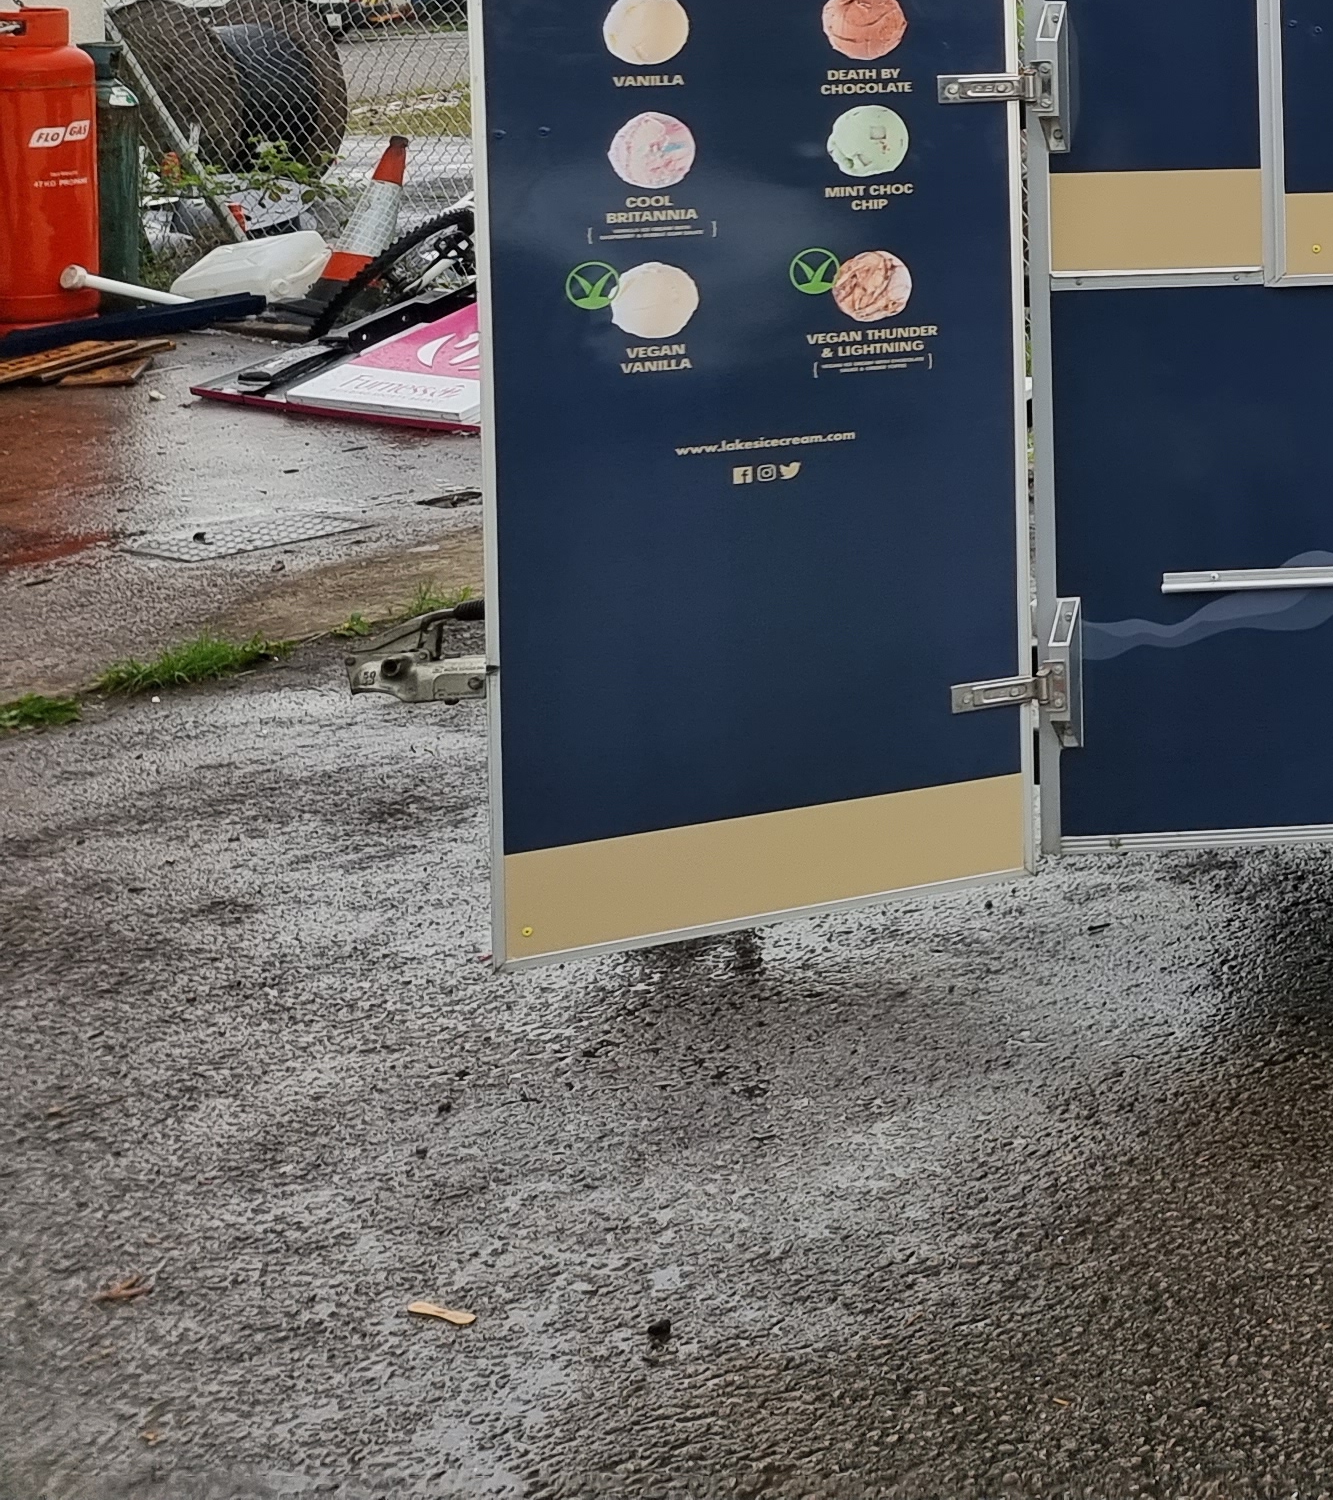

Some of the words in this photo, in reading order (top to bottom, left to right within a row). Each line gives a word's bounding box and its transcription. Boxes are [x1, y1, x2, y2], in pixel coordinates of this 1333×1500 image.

[612, 75, 685, 87] VANILLA
[827, 69, 877, 81] DEATH
[881, 68, 900, 78] BY
[821, 82, 912, 95] CHOCOLATE
[36, 133, 60, 142] FLO
[69, 125, 87, 136] GAS
[825, 186, 866, 198] MINT
[869, 183, 914, 196] CHOC
[625, 195, 674, 208] COOL
[852, 199, 888, 210] CHIP
[606, 209, 698, 224] BRITANNIA
[807, 331, 862, 345] VEGAN
[866, 325, 938, 340] THUNDER
[626, 344, 686, 358] VEGAN
[821, 348, 834, 358] &
[838, 340, 924, 357] LIGHTNING
[620, 358, 692, 373] VANILLA
[675, 431, 856, 456] www.lakesicecream.com
